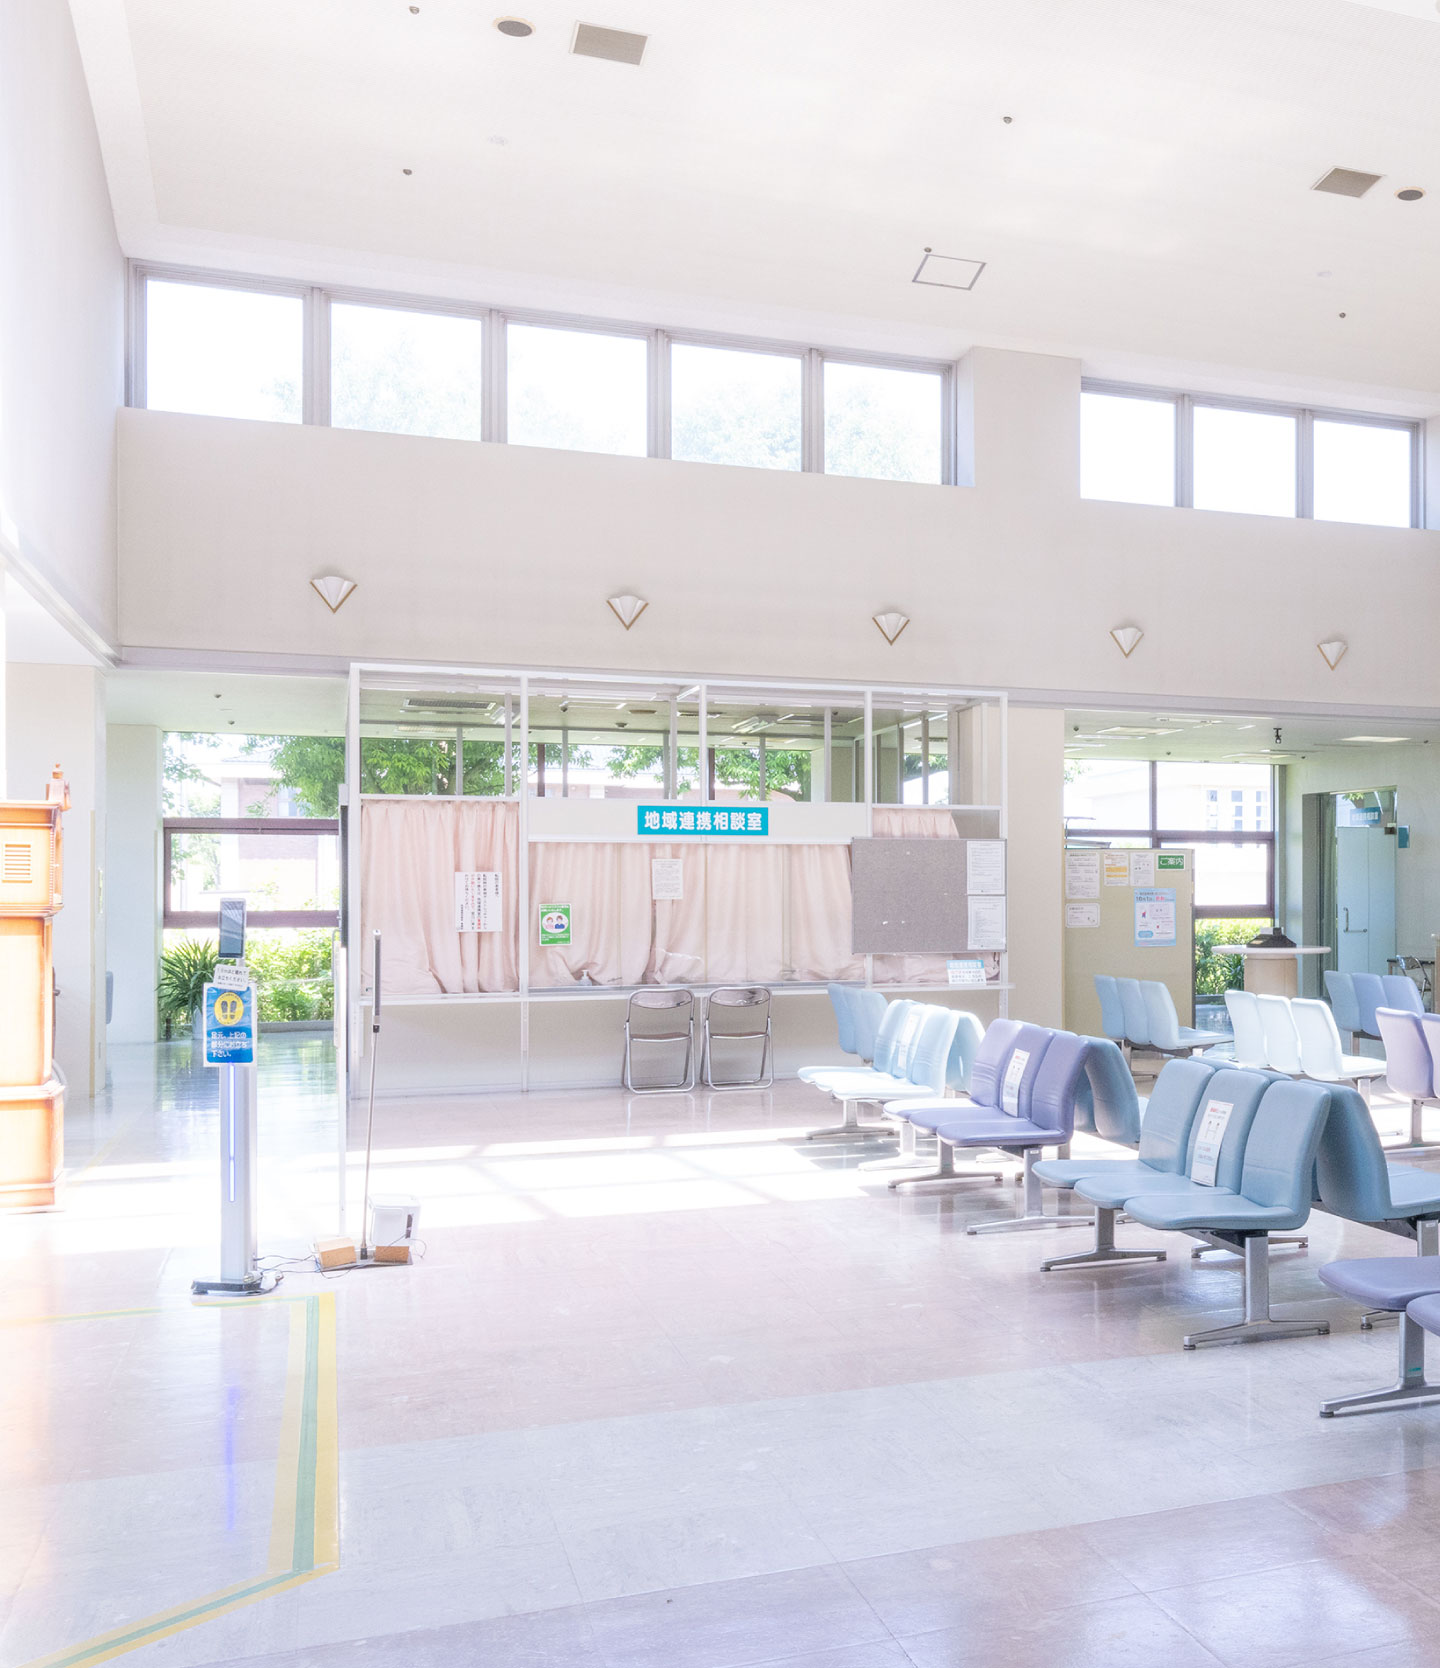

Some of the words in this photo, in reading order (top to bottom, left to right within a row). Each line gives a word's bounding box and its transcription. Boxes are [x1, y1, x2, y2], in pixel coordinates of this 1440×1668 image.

[644, 811, 763, 831] 地域連携相談室
[1159, 856, 1184, 866] ご案内
